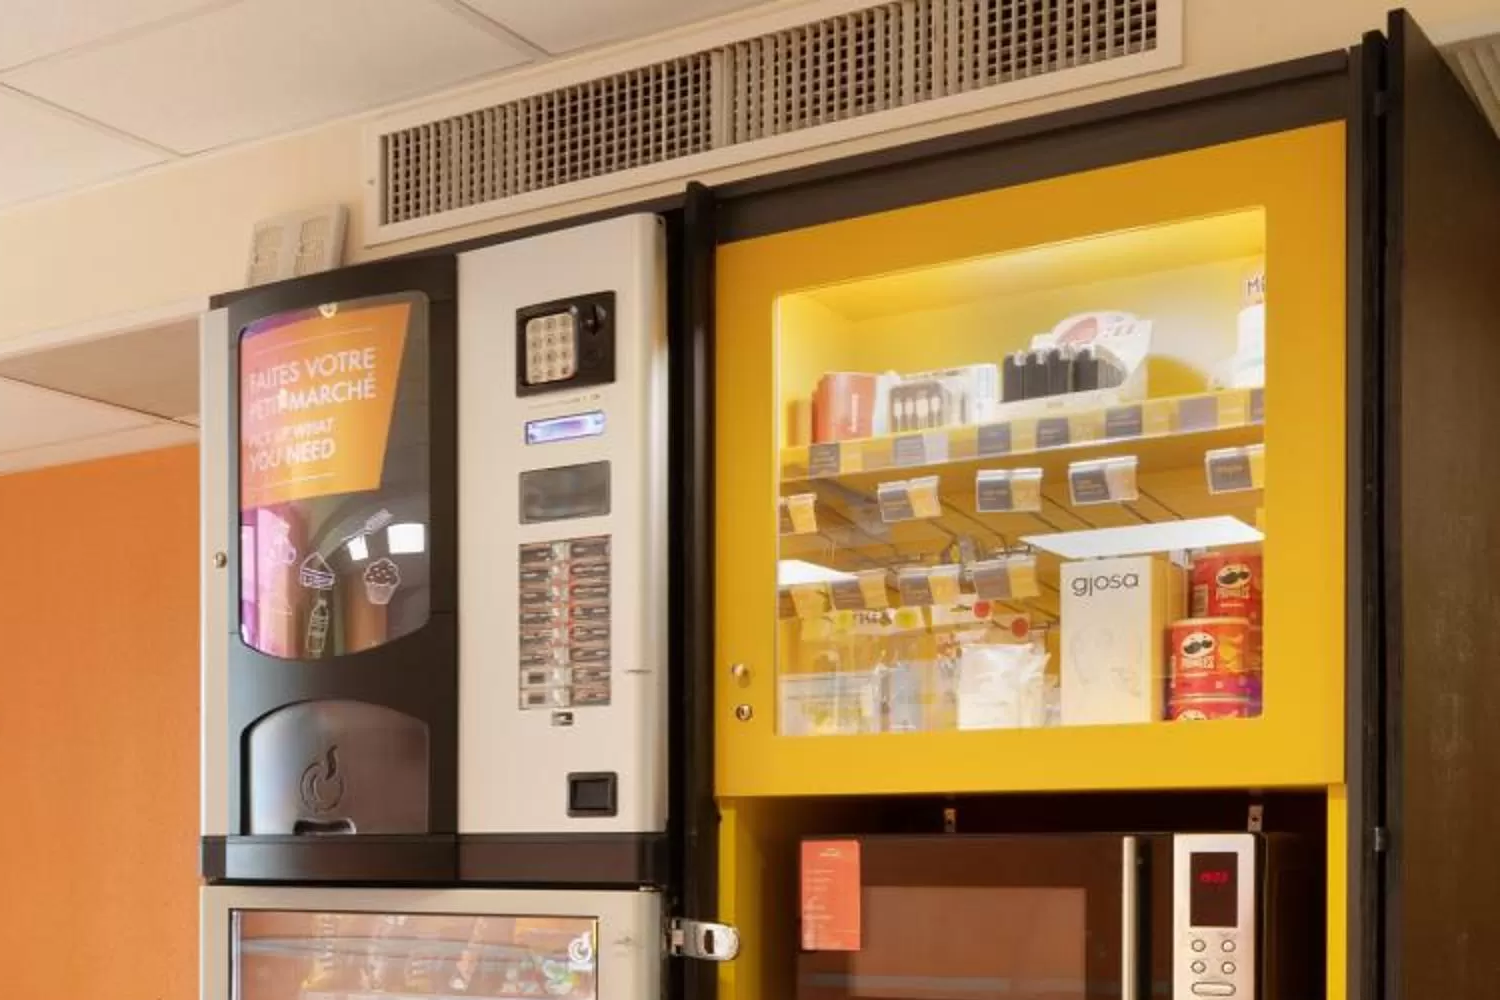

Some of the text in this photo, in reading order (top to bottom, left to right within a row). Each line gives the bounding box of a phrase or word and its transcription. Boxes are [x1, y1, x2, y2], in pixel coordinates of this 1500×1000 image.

[303, 348, 375, 378] VOTRE
[289, 374, 375, 410] MARCHÉ
[286, 438, 335, 464] NEED
